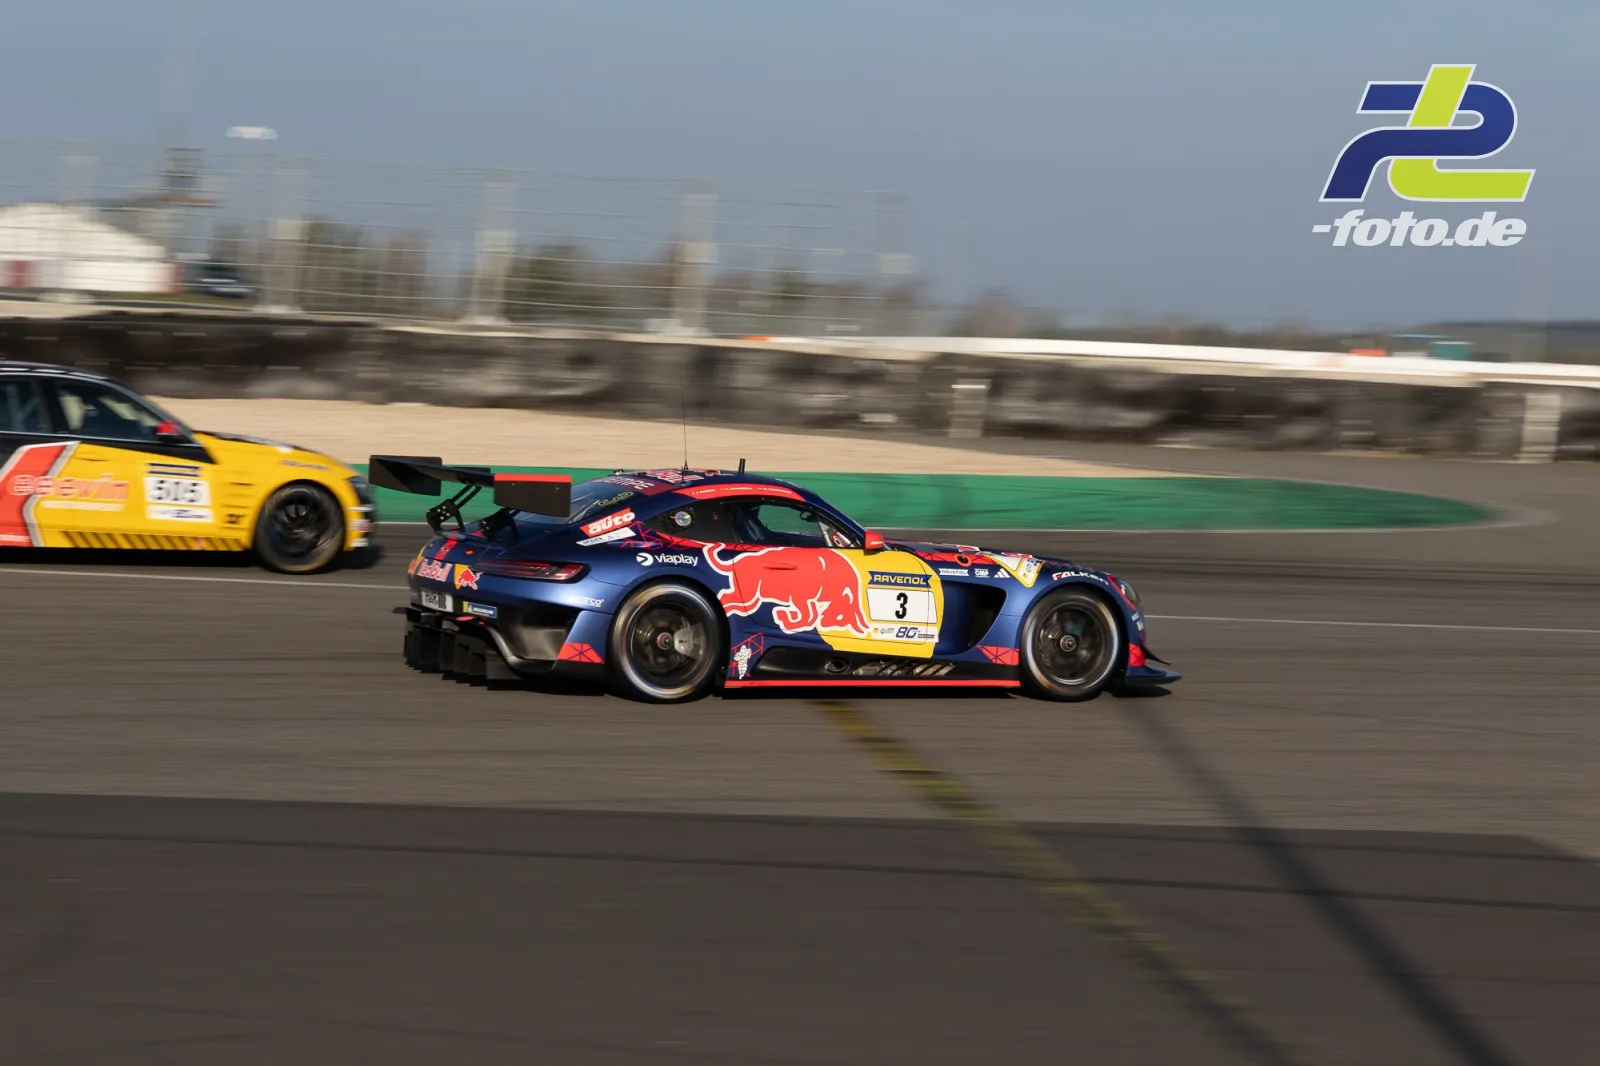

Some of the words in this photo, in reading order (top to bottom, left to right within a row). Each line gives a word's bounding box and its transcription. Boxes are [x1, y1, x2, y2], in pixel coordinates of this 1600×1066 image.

[655, 553, 698, 567] viaplay
[873, 574, 927, 585] RAVENOL
[1052, 571, 1110, 586] FALKEN
[895, 592, 908, 619] 3
